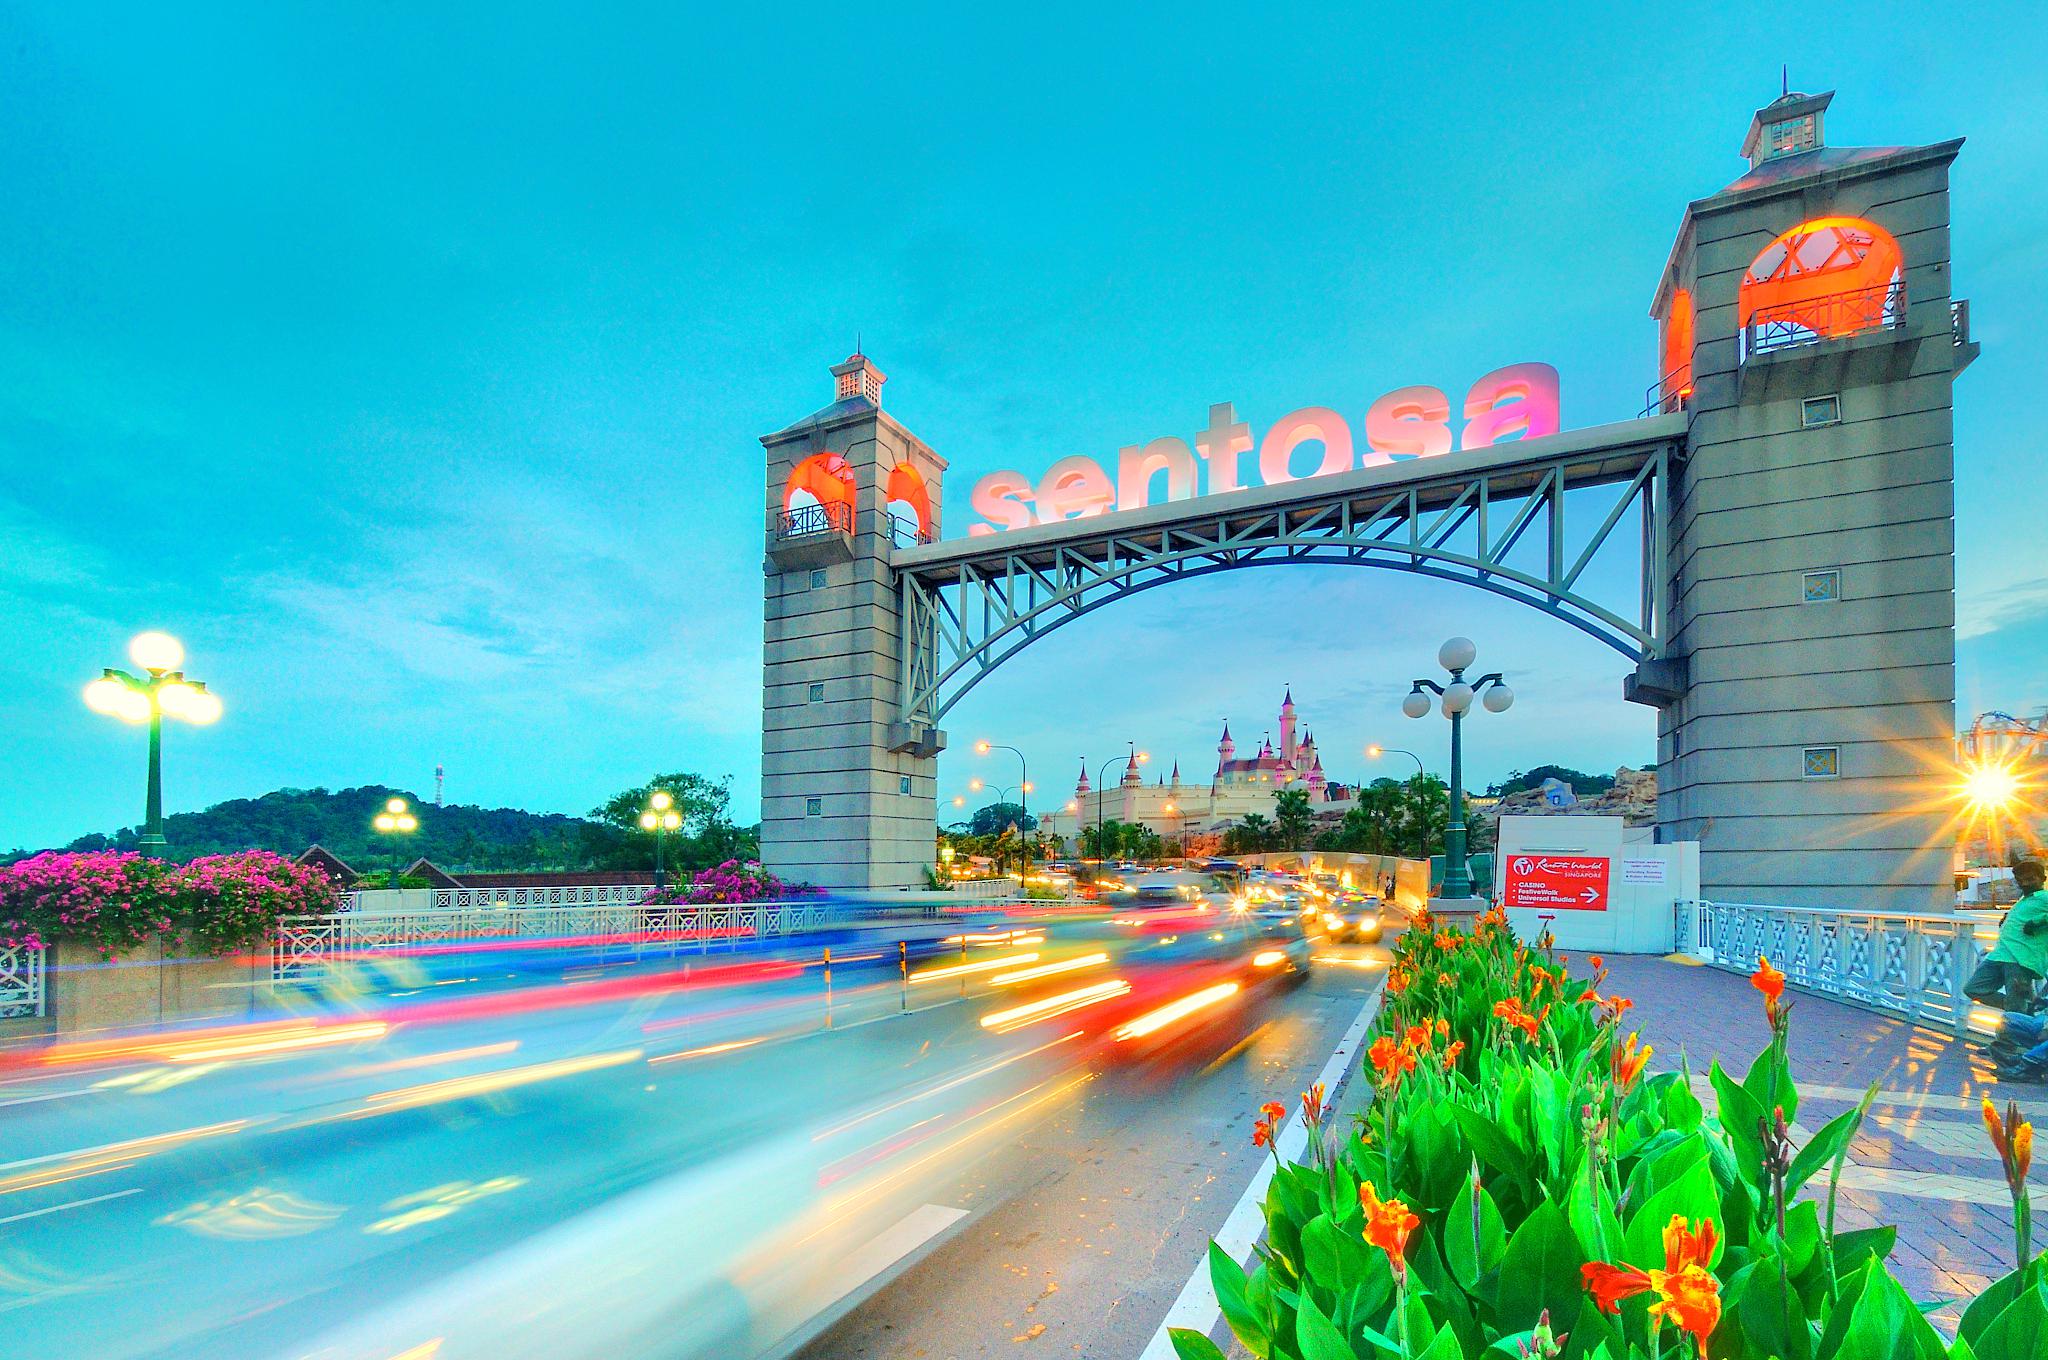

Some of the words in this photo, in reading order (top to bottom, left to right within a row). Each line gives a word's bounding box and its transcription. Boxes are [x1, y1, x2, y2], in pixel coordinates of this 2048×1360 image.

[969, 362, 1560, 538] sentosa
[1571, 861, 1602, 870] World
[1518, 888, 1559, 896] FestiveWalk
[1518, 894, 1550, 902] Universal
